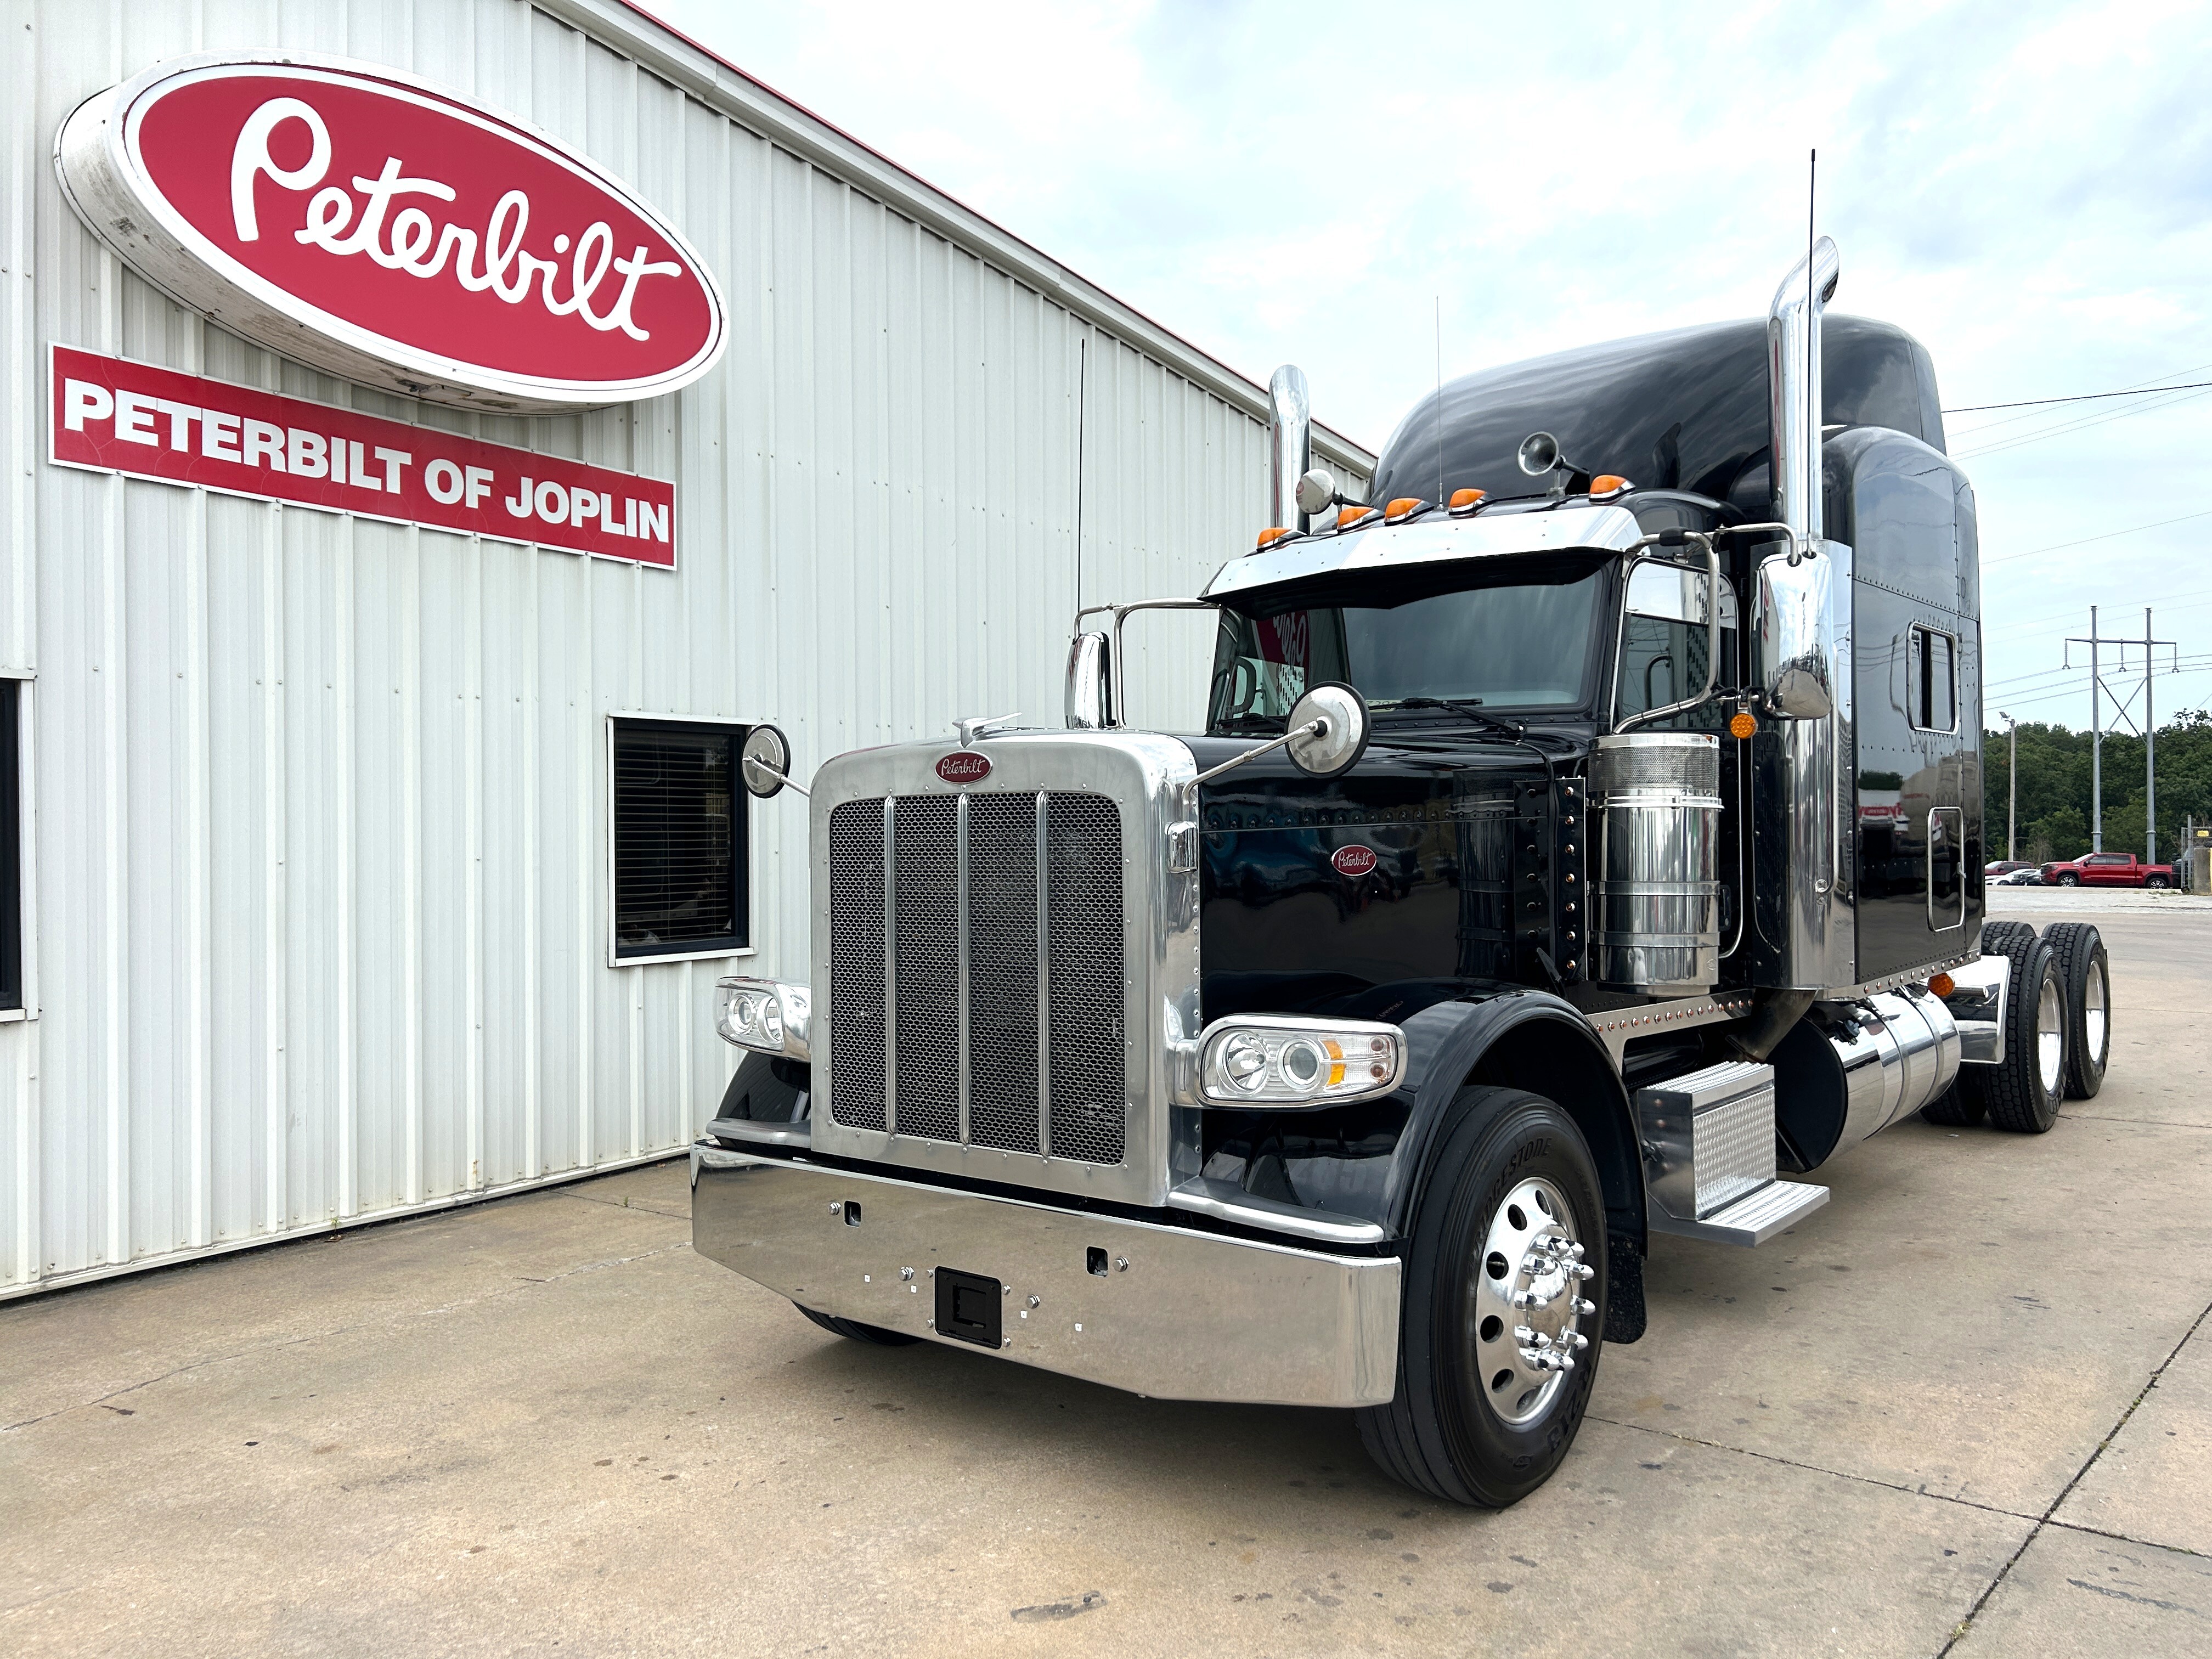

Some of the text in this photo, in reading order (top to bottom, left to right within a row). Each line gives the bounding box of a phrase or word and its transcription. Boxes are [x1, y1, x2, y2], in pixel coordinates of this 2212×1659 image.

[231, 97, 682, 341] Peterbilt
[64, 377, 669, 544] PETERBILT OF JOPLIN
[941, 758, 986, 776] Peterbilt
[1338, 851, 1373, 868] Peterbilt
